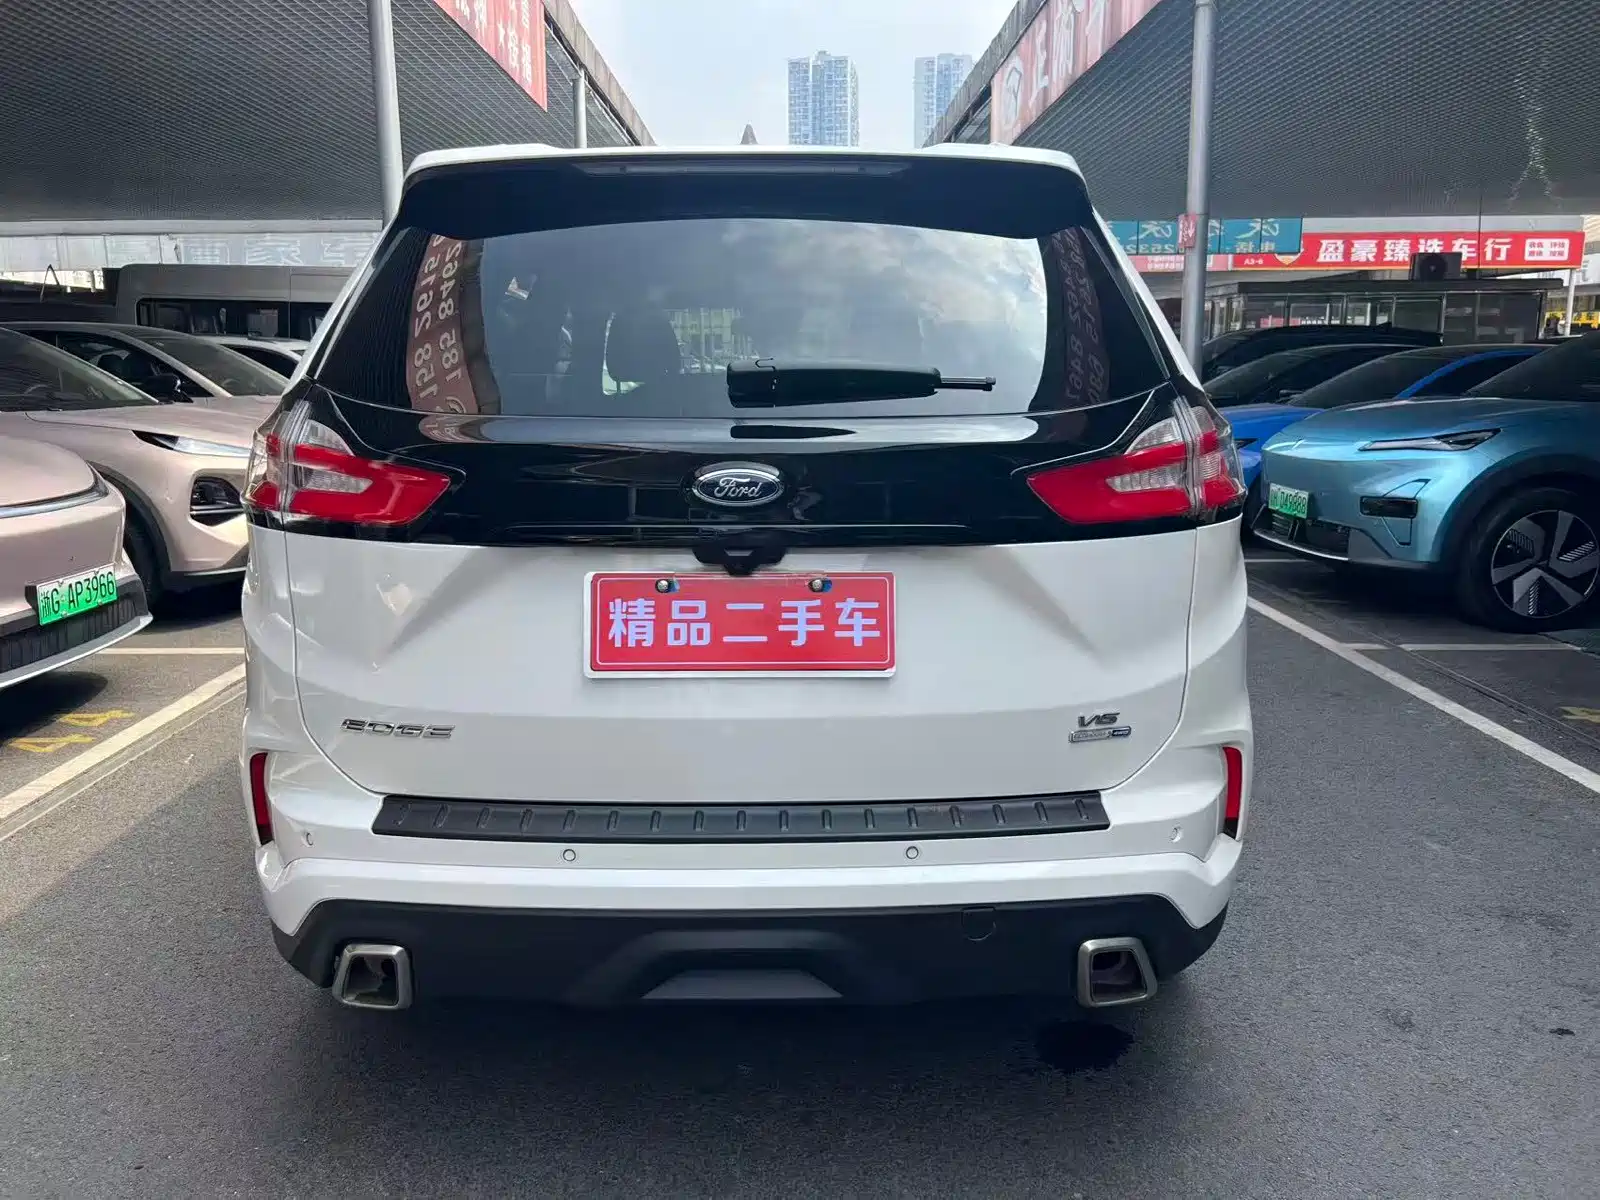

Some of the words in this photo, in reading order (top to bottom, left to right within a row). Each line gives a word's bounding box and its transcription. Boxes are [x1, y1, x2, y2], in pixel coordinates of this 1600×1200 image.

[1317, 238, 1512, 263] 盈豪臻选车行
[713, 476, 763, 499] Ford
[608, 597, 881, 648] 精品二手车
[340, 718, 455, 739] EDGE
